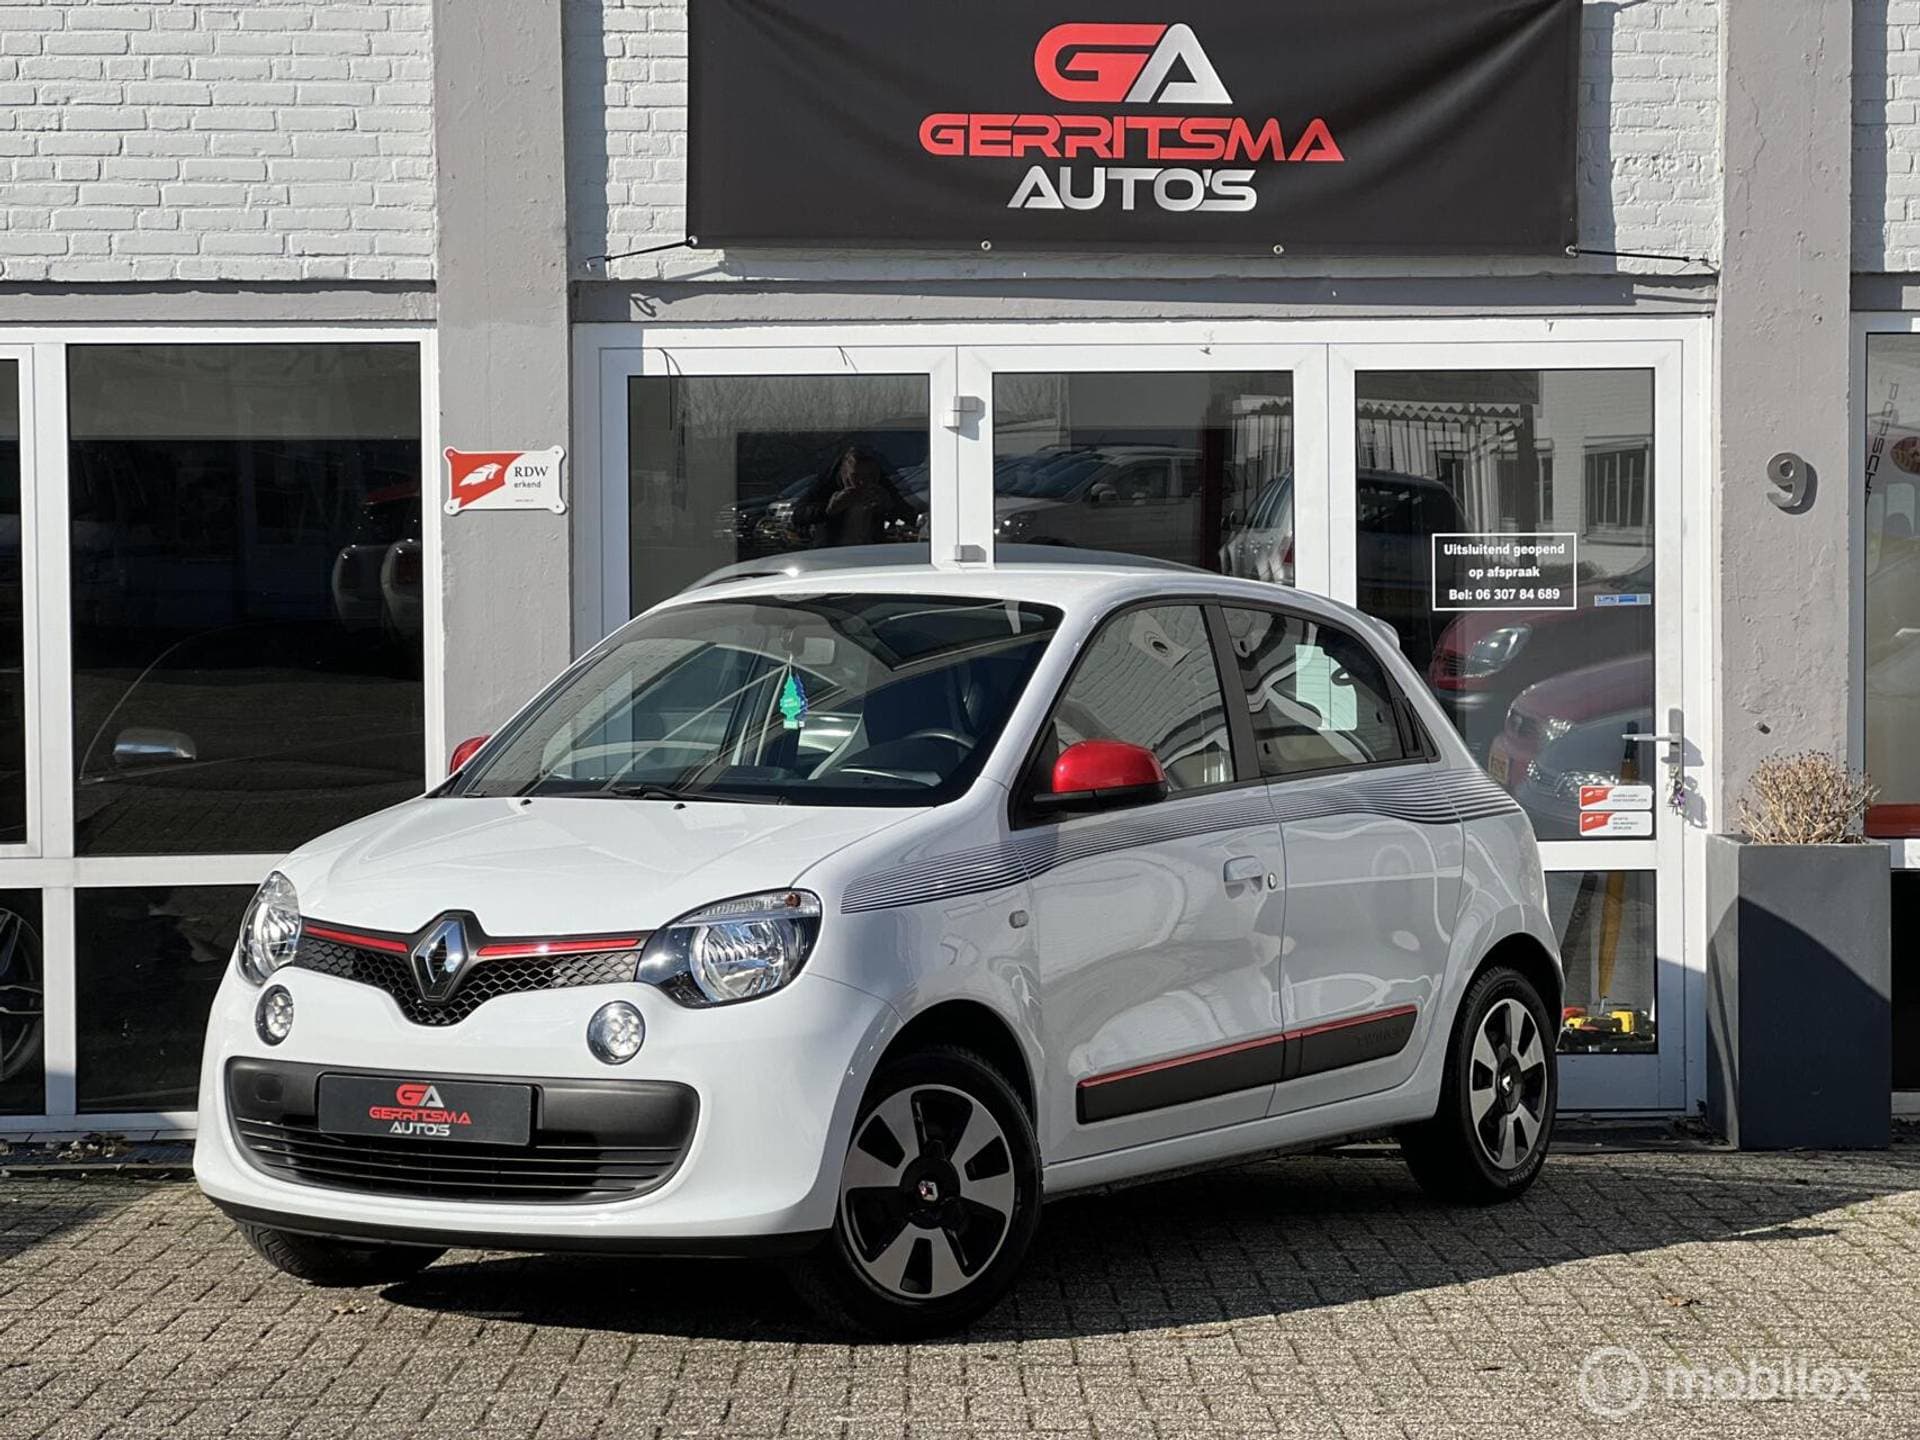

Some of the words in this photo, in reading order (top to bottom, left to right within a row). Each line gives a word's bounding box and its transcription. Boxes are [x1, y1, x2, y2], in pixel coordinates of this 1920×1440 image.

[1034, 22, 1233, 104] GA
[918, 112, 1345, 162] GERRITSMA
[1007, 165, 1258, 212] AUTO'S
[514, 466, 549, 477] RDW
[1766, 452, 1808, 508] 9
[1444, 543, 1510, 555] Uitsluitend
[1513, 543, 1565, 558] geopend
[1468, 568, 1484, 580] op
[1487, 566, 1540, 580] afspraak
[1449, 589, 1473, 600] Bel:
[1475, 589, 1491, 600] 06
[1493, 589, 1516, 600] 307
[1519, 589, 1535, 600] 84
[1538, 588, 1560, 600] 689
[396, 1083, 444, 1107] GA
[369, 1106, 472, 1124] GERRITSMA
[390, 1121, 450, 1136] AUTO'S
